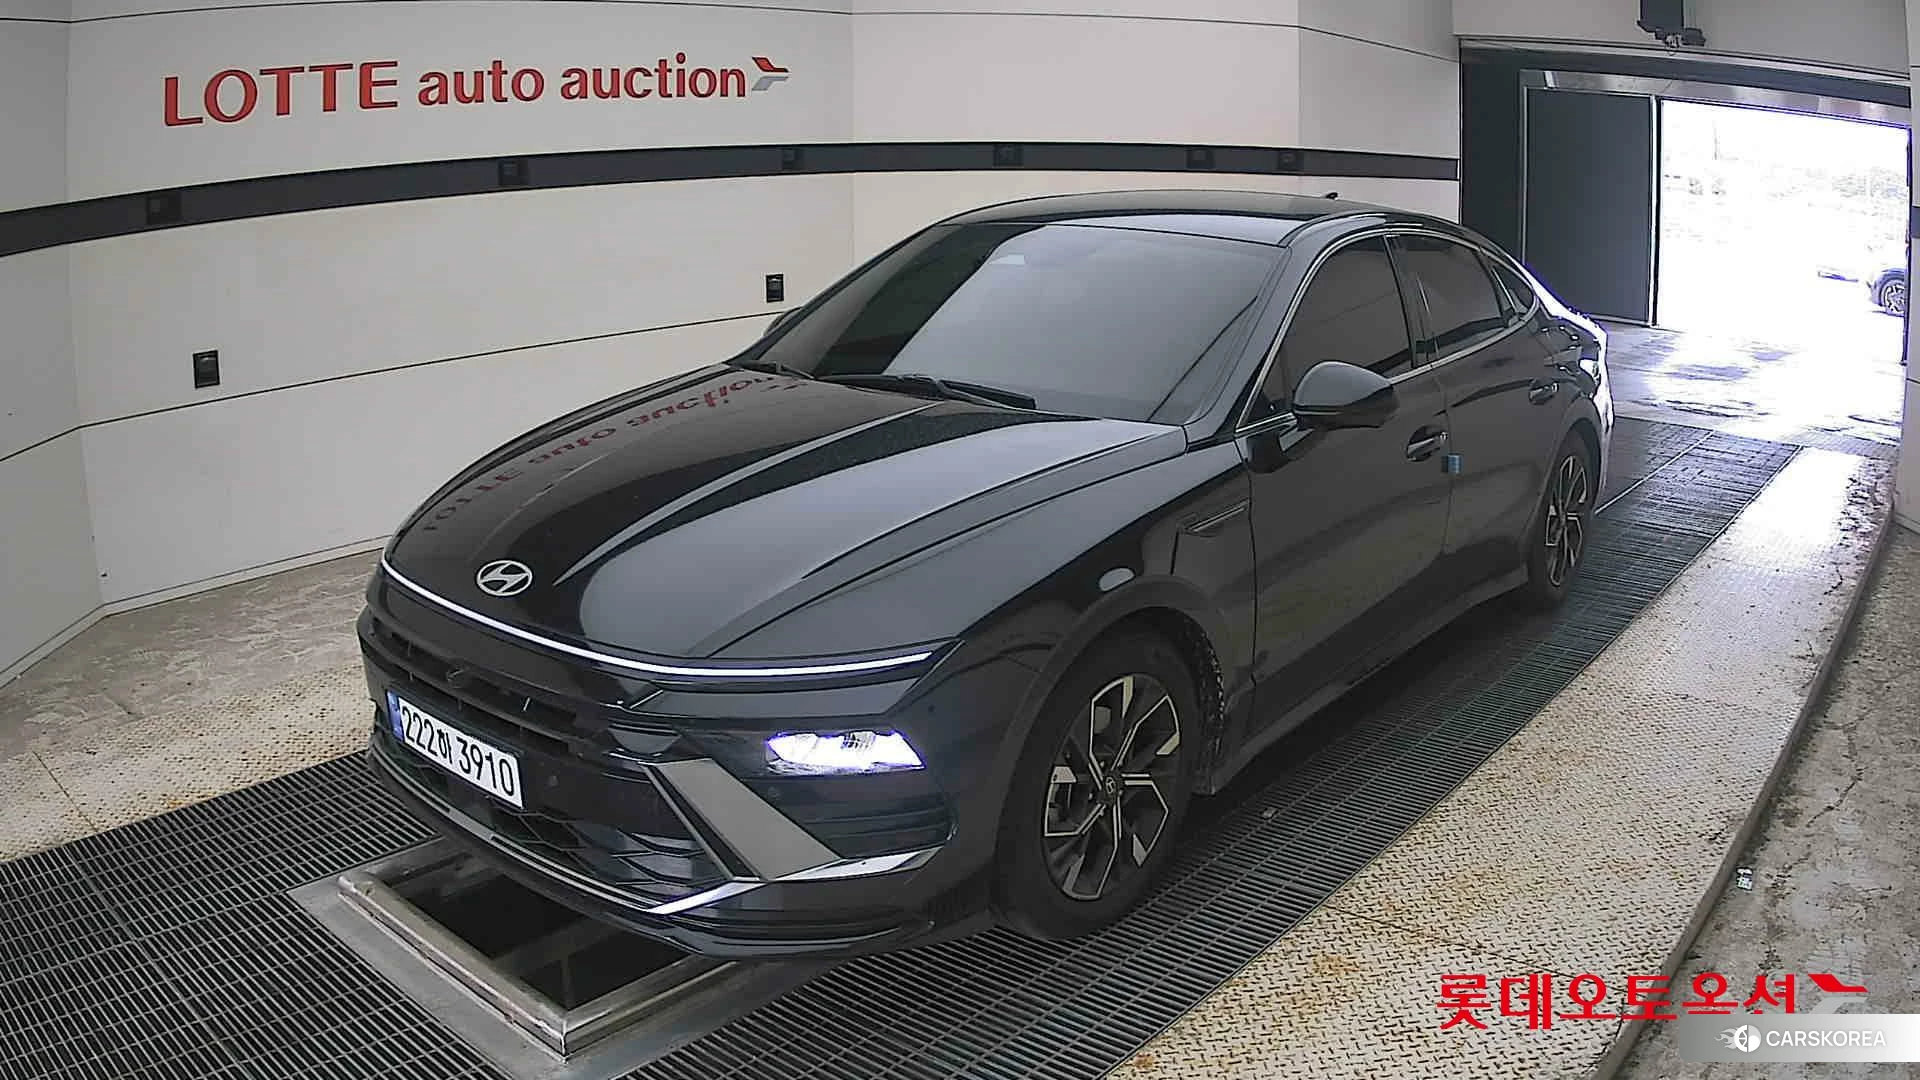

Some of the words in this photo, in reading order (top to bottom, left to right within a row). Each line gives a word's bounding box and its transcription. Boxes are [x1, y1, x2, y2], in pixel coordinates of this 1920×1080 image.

[163, 60, 399, 127] LOTTE
[417, 59, 545, 107] auto
[560, 52, 746, 100] auction
[457, 735, 514, 797] 3910
